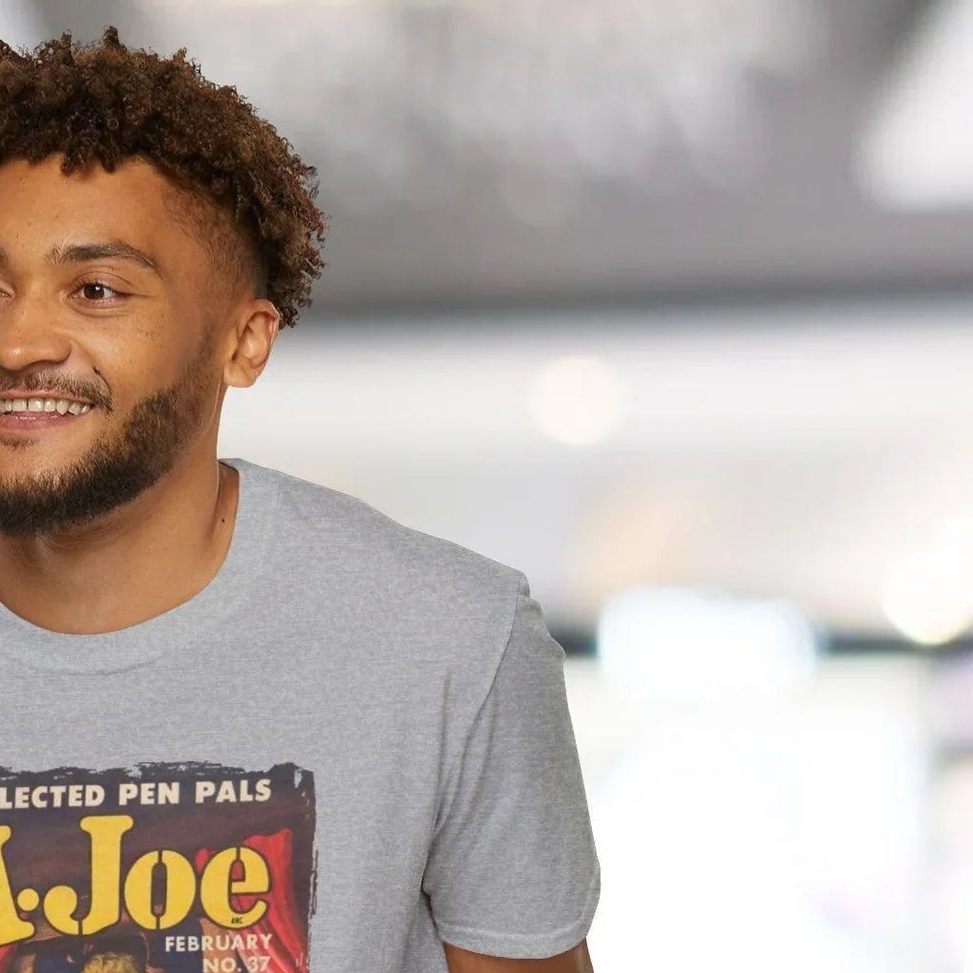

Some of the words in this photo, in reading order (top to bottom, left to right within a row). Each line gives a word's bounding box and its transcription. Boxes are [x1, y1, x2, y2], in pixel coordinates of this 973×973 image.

[118, 782, 180, 806] PEN
[195, 778, 272, 804] PALS
[165, 933, 273, 952] FEBRUARY
[202, 957, 242, 973] NO.
[247, 956, 271, 972] 37
